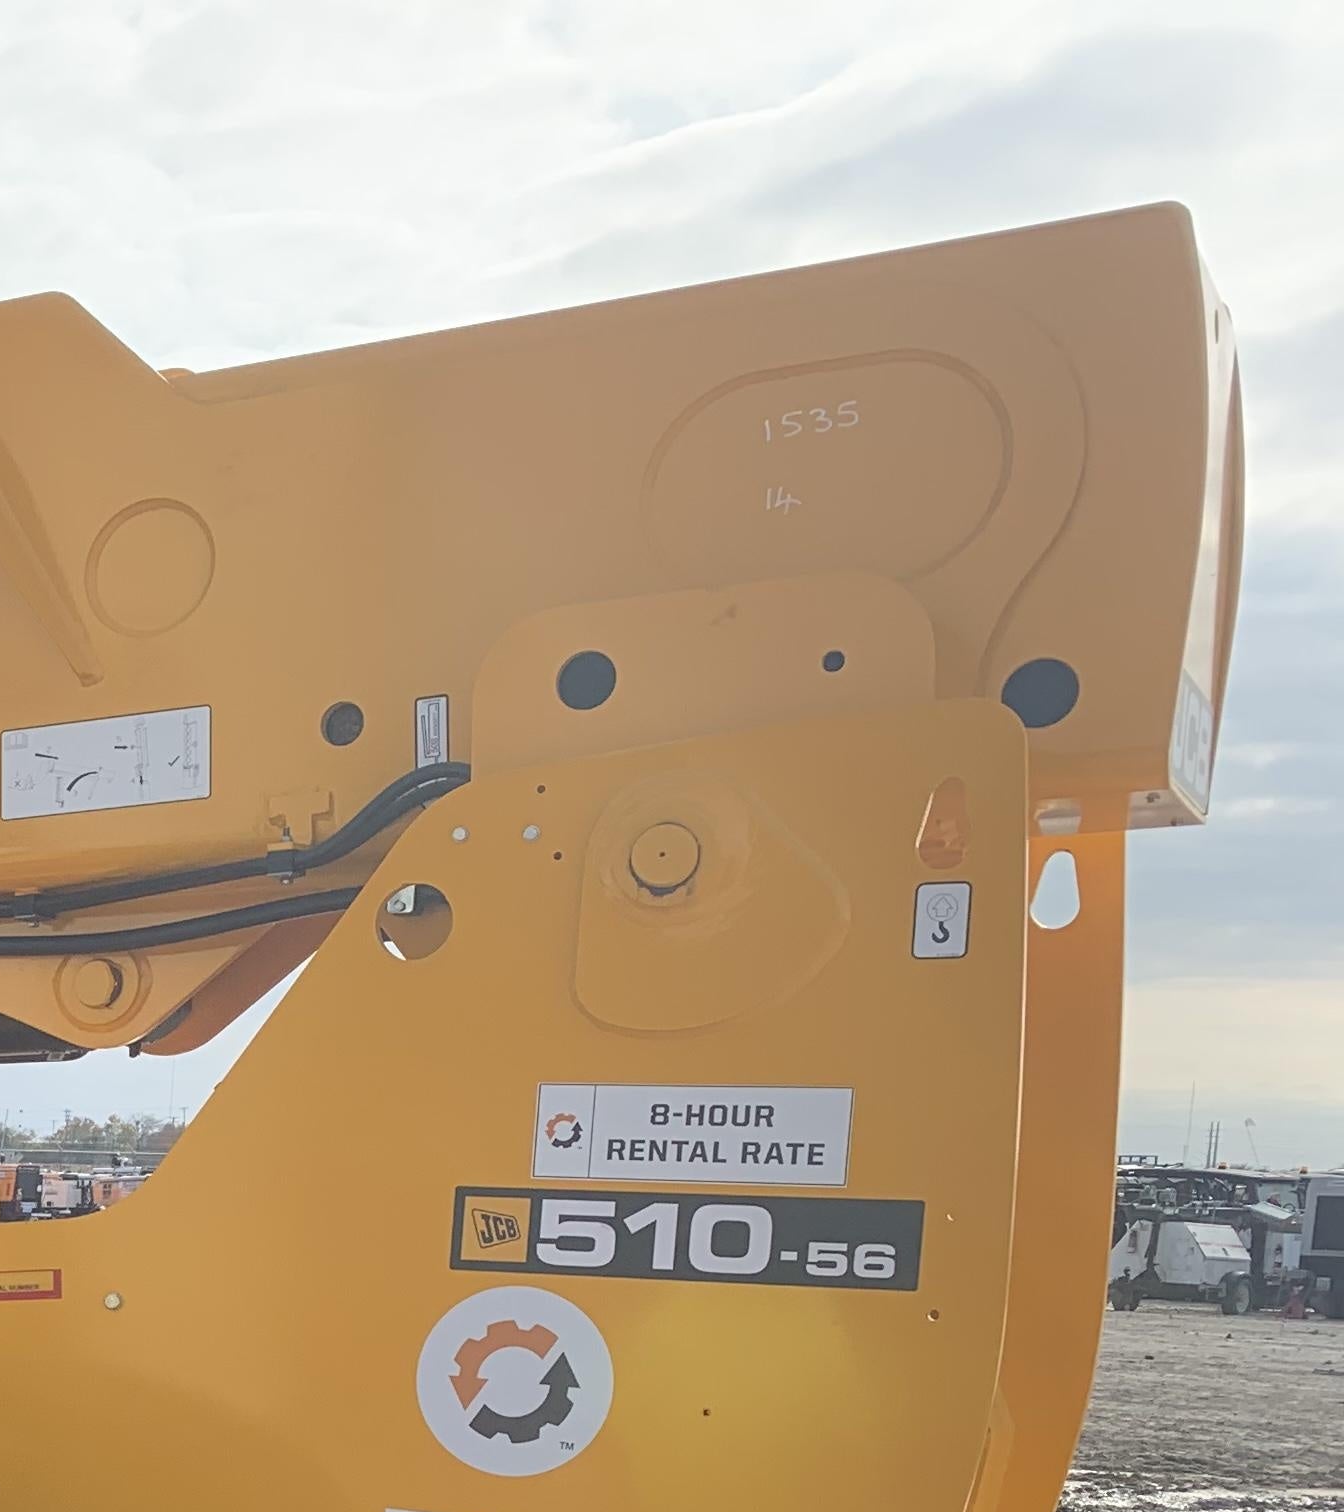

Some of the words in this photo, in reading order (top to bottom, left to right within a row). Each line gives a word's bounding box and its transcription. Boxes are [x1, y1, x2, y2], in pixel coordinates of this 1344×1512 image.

[764, 400, 859, 442] 1535
[765, 486, 802, 515] 14
[649, 1103, 775, 1129] 8-HOUR
[606, 1138, 727, 1165] RENTAL
[740, 1142, 826, 1167] RATE
[480, 1212, 518, 1246] JCB
[535, 1198, 897, 1280] 510-56
[559, 1440, 575, 1451] TM
